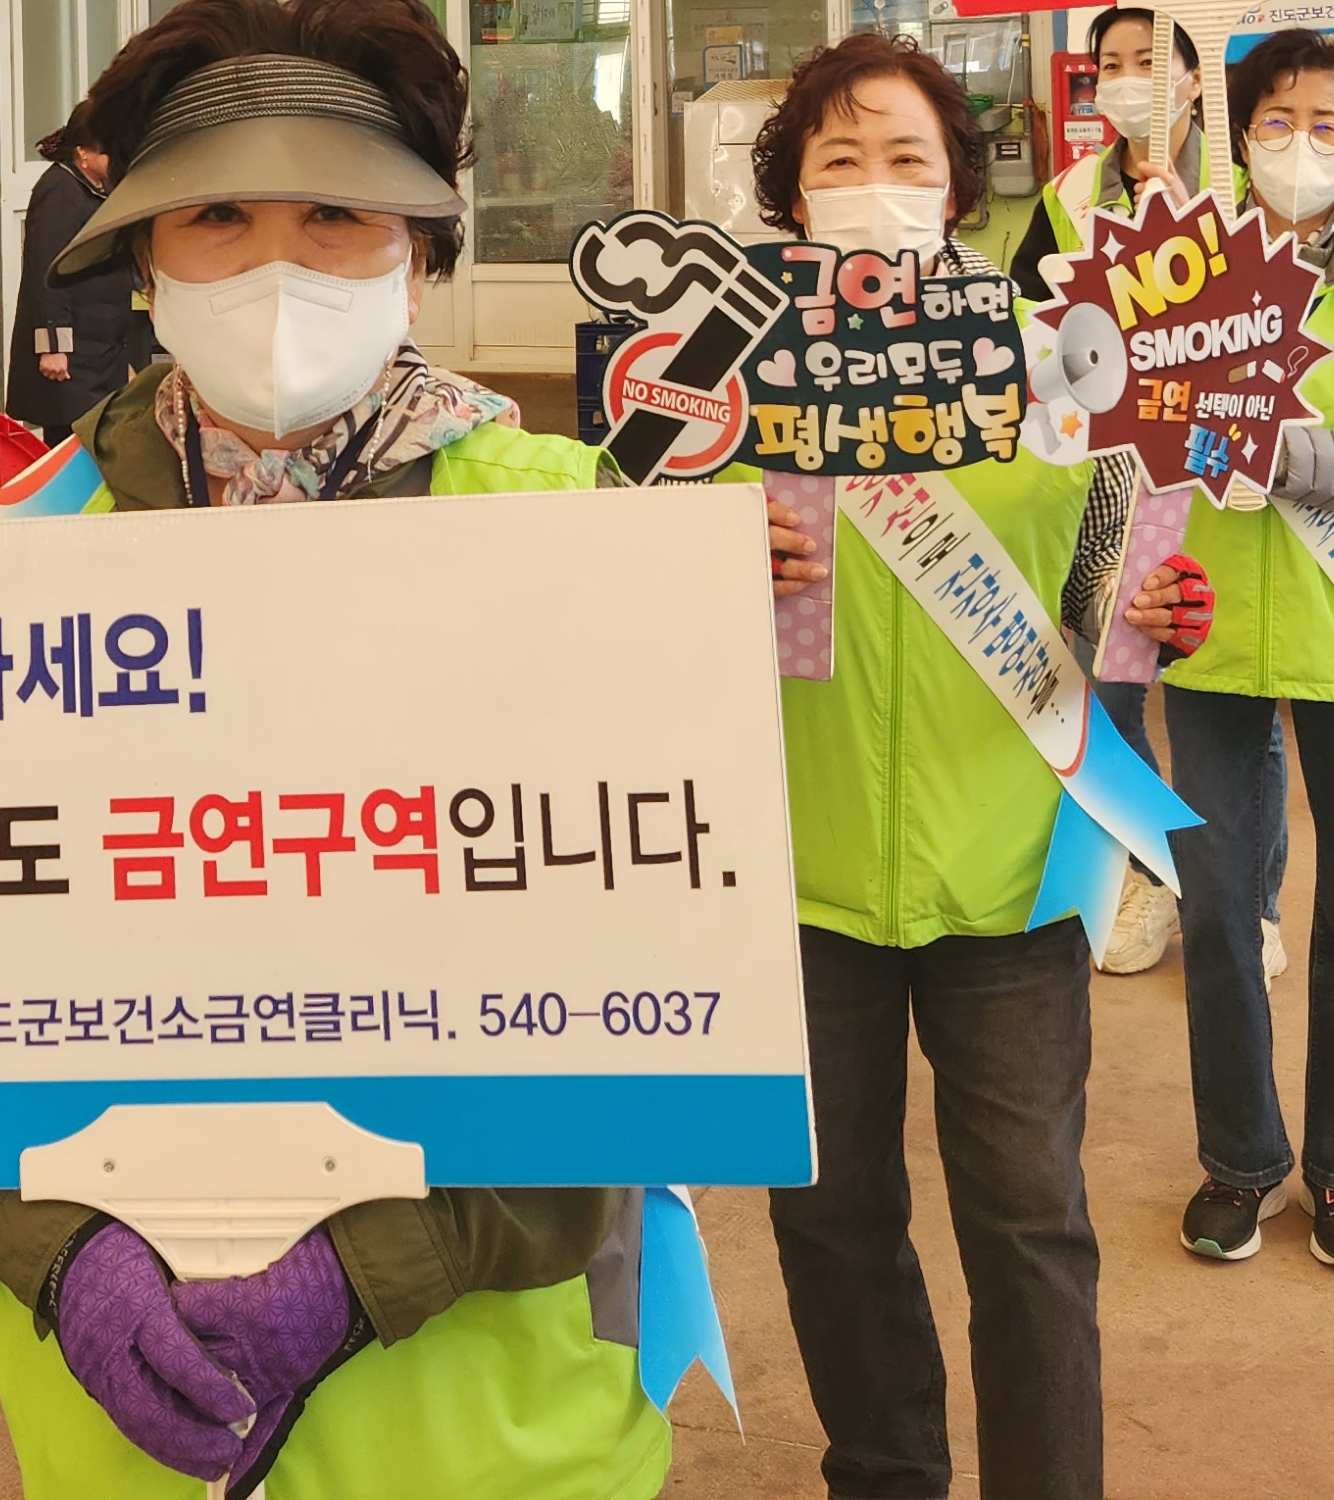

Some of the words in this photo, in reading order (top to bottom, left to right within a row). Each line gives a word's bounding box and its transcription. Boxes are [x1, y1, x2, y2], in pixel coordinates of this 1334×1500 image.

[781, 245, 1011, 337] 금연하면
[1105, 212, 1228, 331] NO!
[804, 339, 964, 391] 우리모두
[1130, 304, 1283, 372] SMOKING
[622, 380, 648, 401] NO
[650, 385, 732, 425] SMOKING
[749, 383, 1021, 472] 평생행복
[1138, 378, 1191, 422] 금연
[1195, 391, 1244, 420] 선택이
[1246, 394, 1275, 421] 아닌
[1184, 423, 1229, 478] 필수
[102, 778, 738, 902] 금연구역입니다.
[478, 989, 721, 1041] 540-6037
